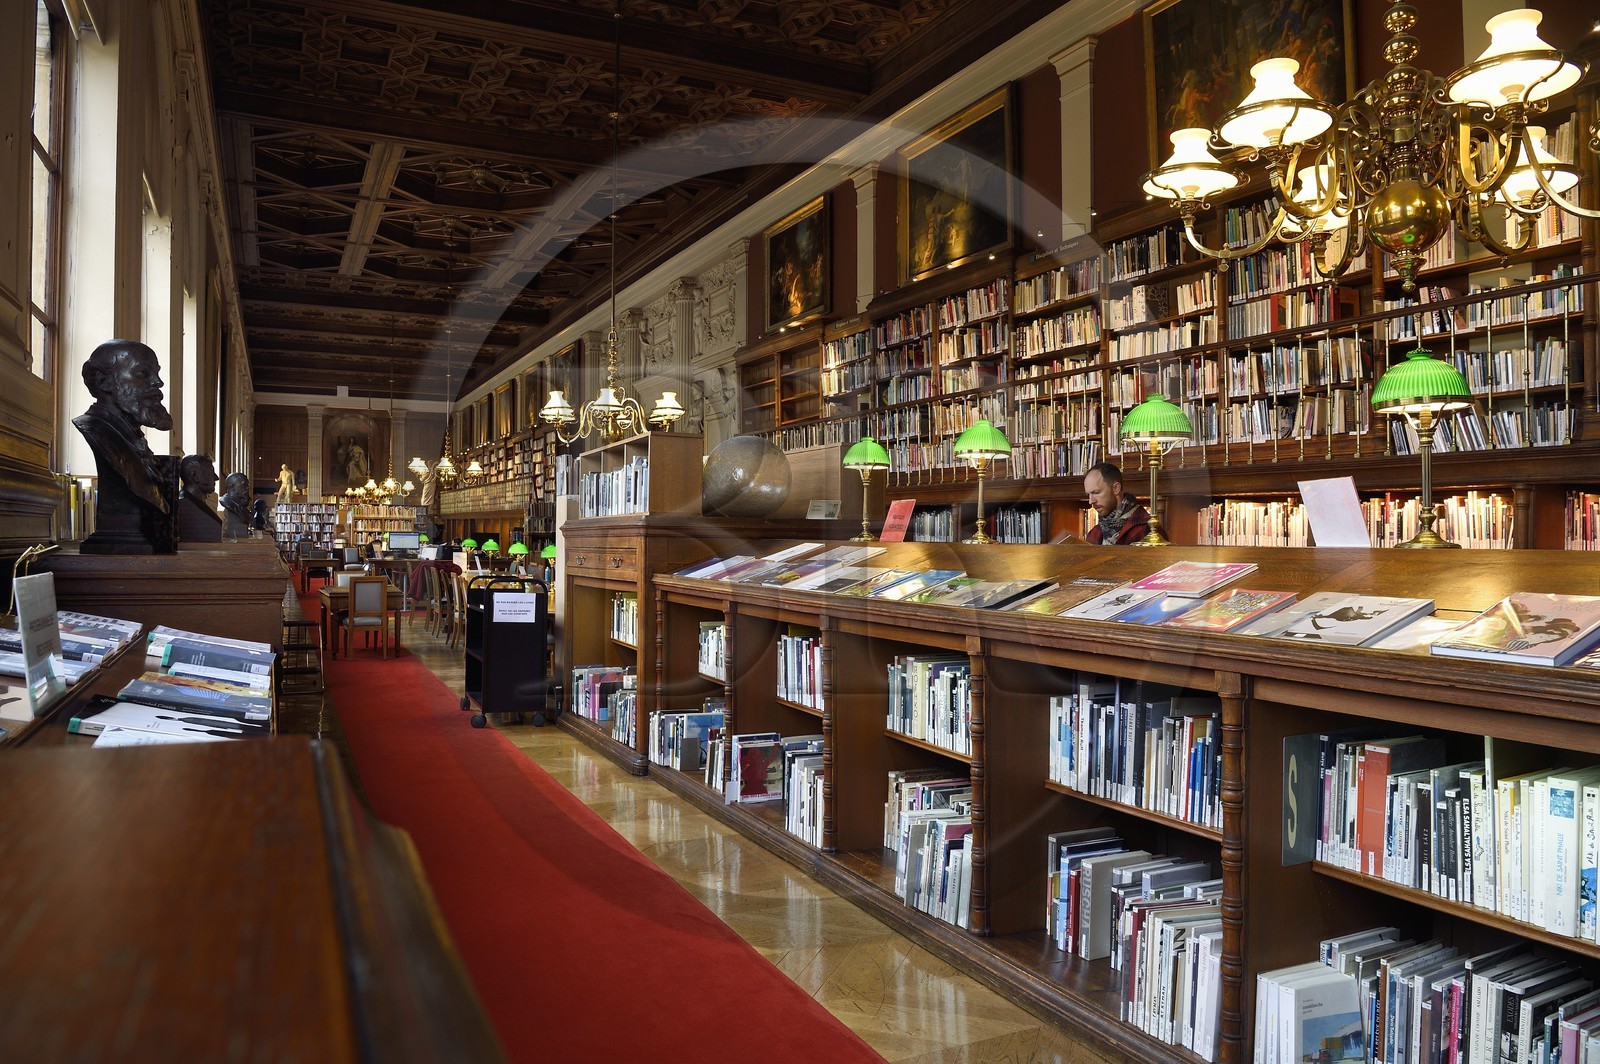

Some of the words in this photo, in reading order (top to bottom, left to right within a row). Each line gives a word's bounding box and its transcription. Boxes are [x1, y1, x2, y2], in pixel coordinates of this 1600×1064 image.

[1288, 754, 1297, 848] S
[1557, 874, 1563, 882] DE
[1081, 868, 1091, 928] RUSCHA
[1199, 966, 1208, 987] Ryman
[1506, 995, 1514, 1023] EXODES
